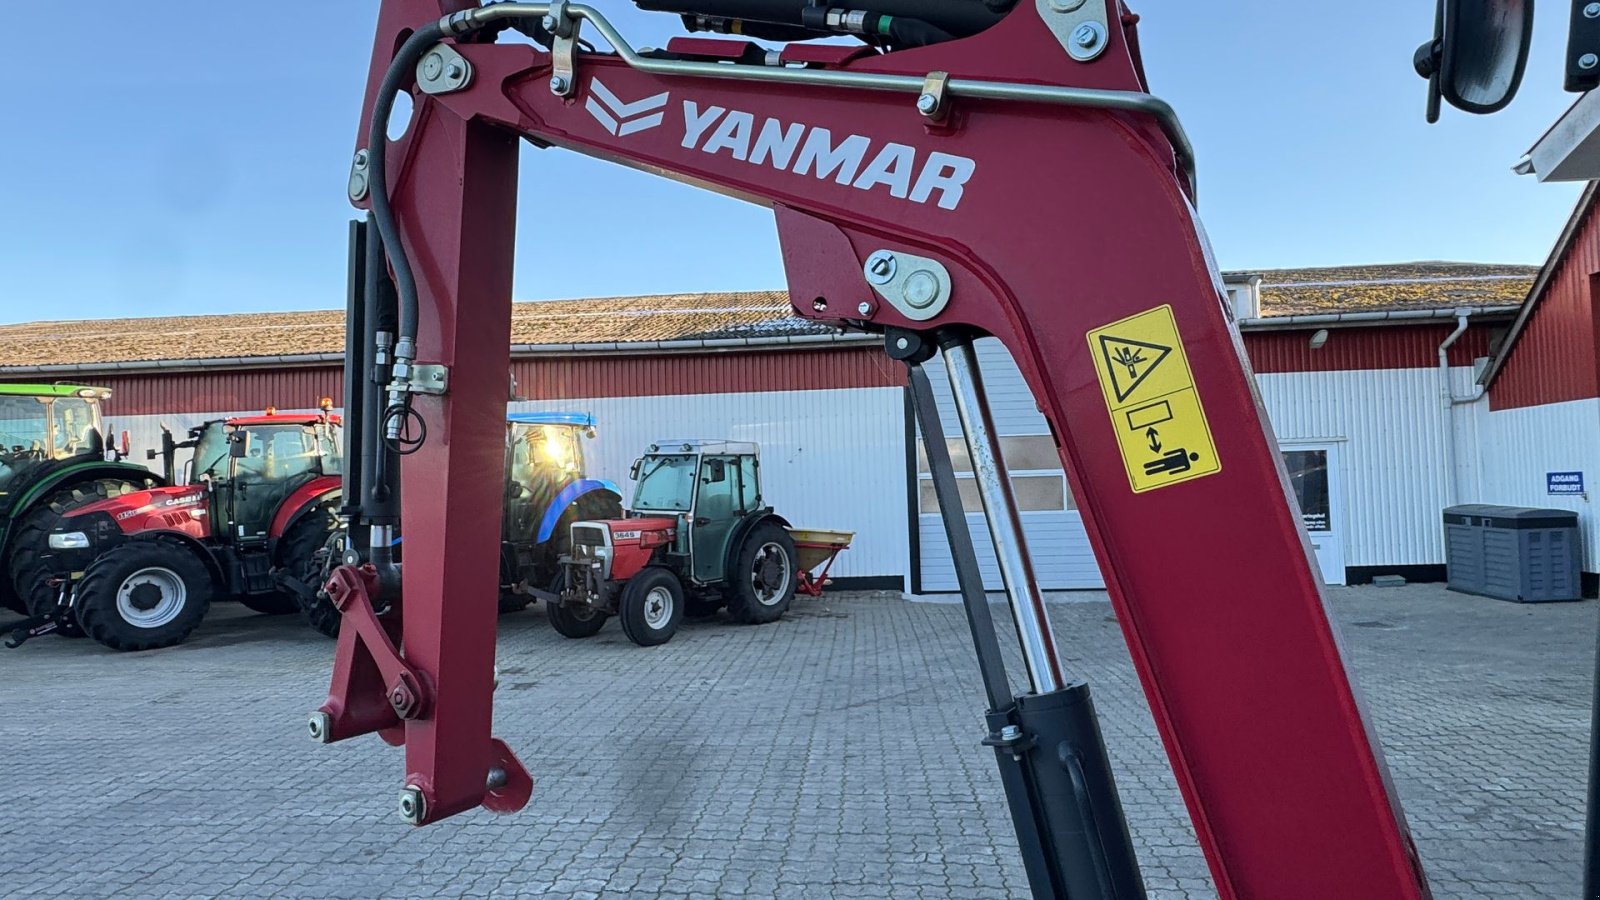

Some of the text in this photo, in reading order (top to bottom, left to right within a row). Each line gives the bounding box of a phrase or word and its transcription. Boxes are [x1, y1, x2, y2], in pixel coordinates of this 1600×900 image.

[681, 99, 976, 211] YANMAR
[1551, 474, 1580, 482] ADGANG
[166, 496, 192, 506] CASE
